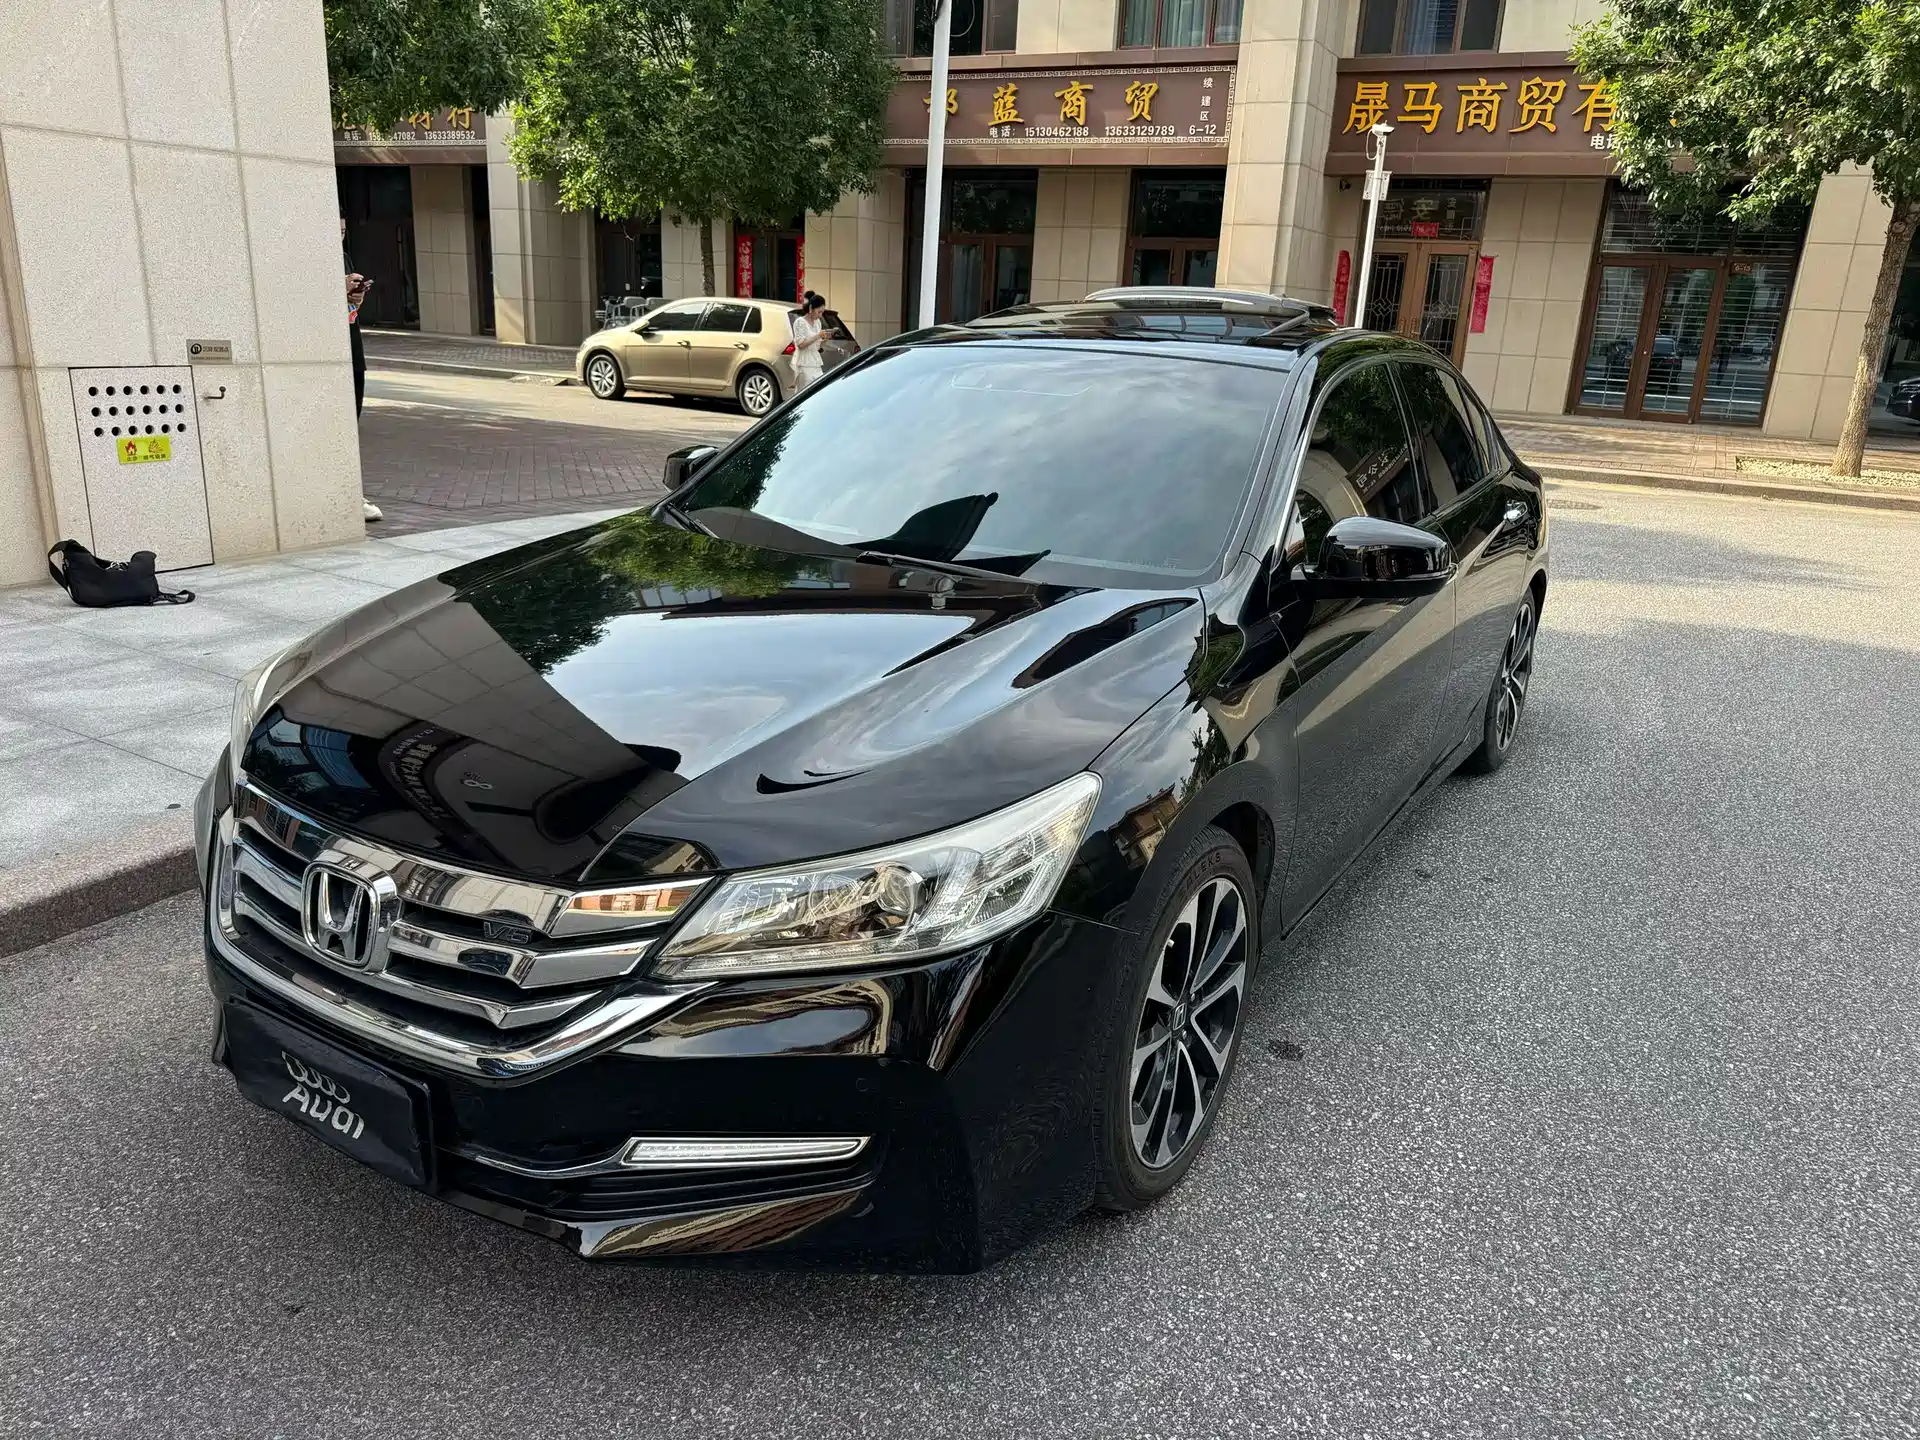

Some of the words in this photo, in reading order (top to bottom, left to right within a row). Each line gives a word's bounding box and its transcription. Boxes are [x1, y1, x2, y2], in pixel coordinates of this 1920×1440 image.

[1199, 77, 1213, 121] 续建区
[1342, 77, 1617, 134] 晟马商贸有
[424, 130, 476, 140] 13633389532
[1024, 126, 1089, 138] 15130462188
[1105, 125, 1175, 136] 13633129789
[1189, 124, 1217, 136] 6-12
